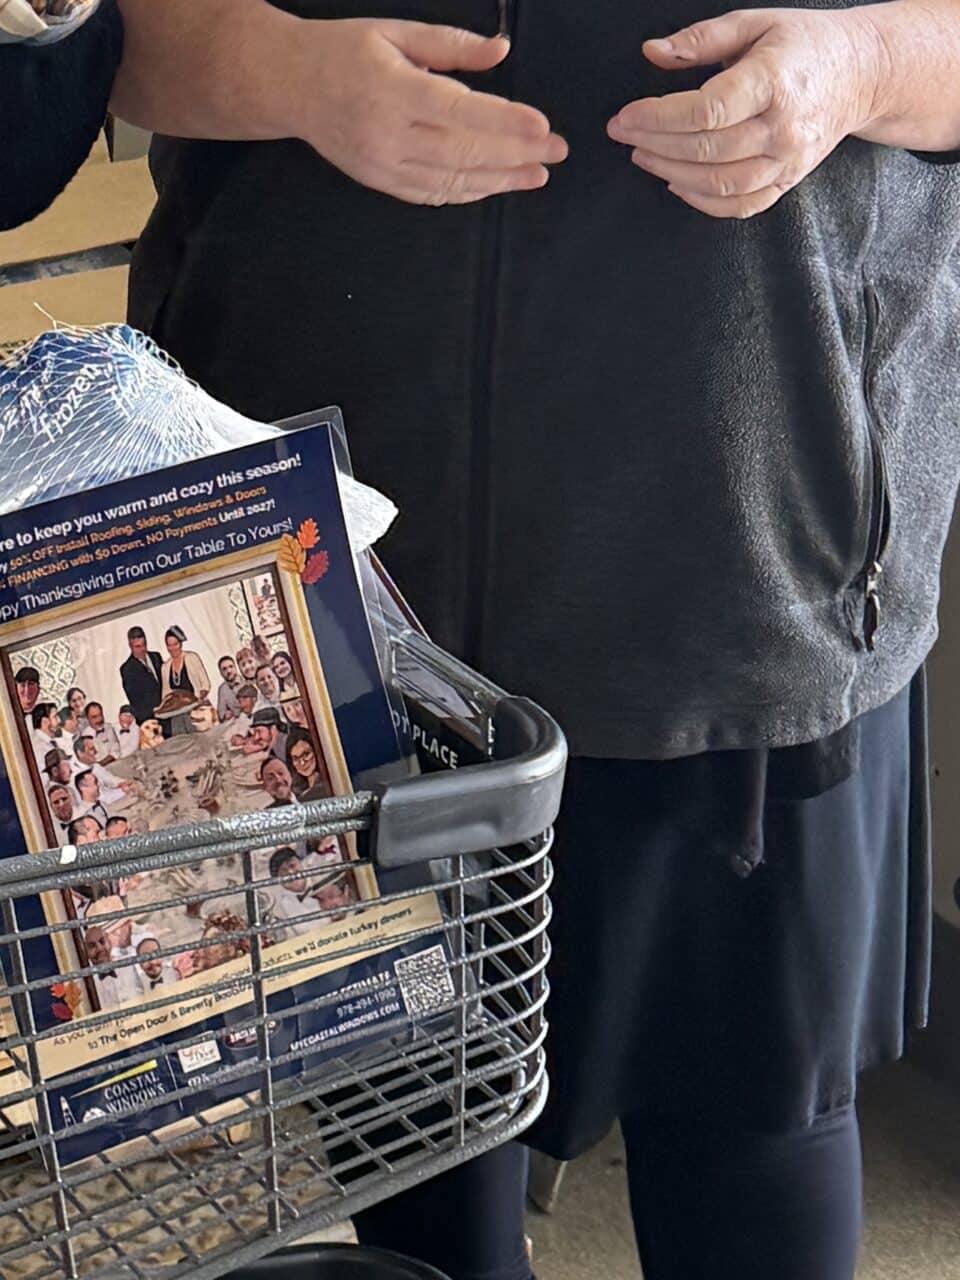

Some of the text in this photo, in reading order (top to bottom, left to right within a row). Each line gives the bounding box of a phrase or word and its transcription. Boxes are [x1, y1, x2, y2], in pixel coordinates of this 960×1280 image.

[16, 531, 33, 547] to
[34, 522, 72, 541] keep
[74, 512, 102, 533] you
[104, 498, 147, 520] warm
[149, 487, 178, 508] and
[181, 478, 214, 499] cozy
[217, 469, 244, 488] this
[246, 453, 302, 481] season!
[32, 545, 55, 561] OFF
[173, 497, 223, 519] Windows
[225, 493, 234, 504] &
[235, 484, 267, 501] Doors
[7, 559, 69, 586] FINANCING
[71, 553, 94, 567] with
[146, 530, 164, 546] NO
[165, 516, 219, 541] Payments
[218, 506, 245, 524] Until
[20, 570, 115, 611] Thanksgiving
[116, 560, 158, 583] From
[156, 550, 182, 570] Our
[184, 538, 225, 560] Table
[226, 531, 247, 548] To
[248, 517, 294, 541] Yours!
[413, 724, 460, 769] PLACE
[100, 1032, 118, 1045] The
[120, 1023, 145, 1040] Open
[147, 1013, 169, 1029] Door
[179, 996, 213, 1017] Beverly
[104, 1071, 160, 1101] COASTAL
